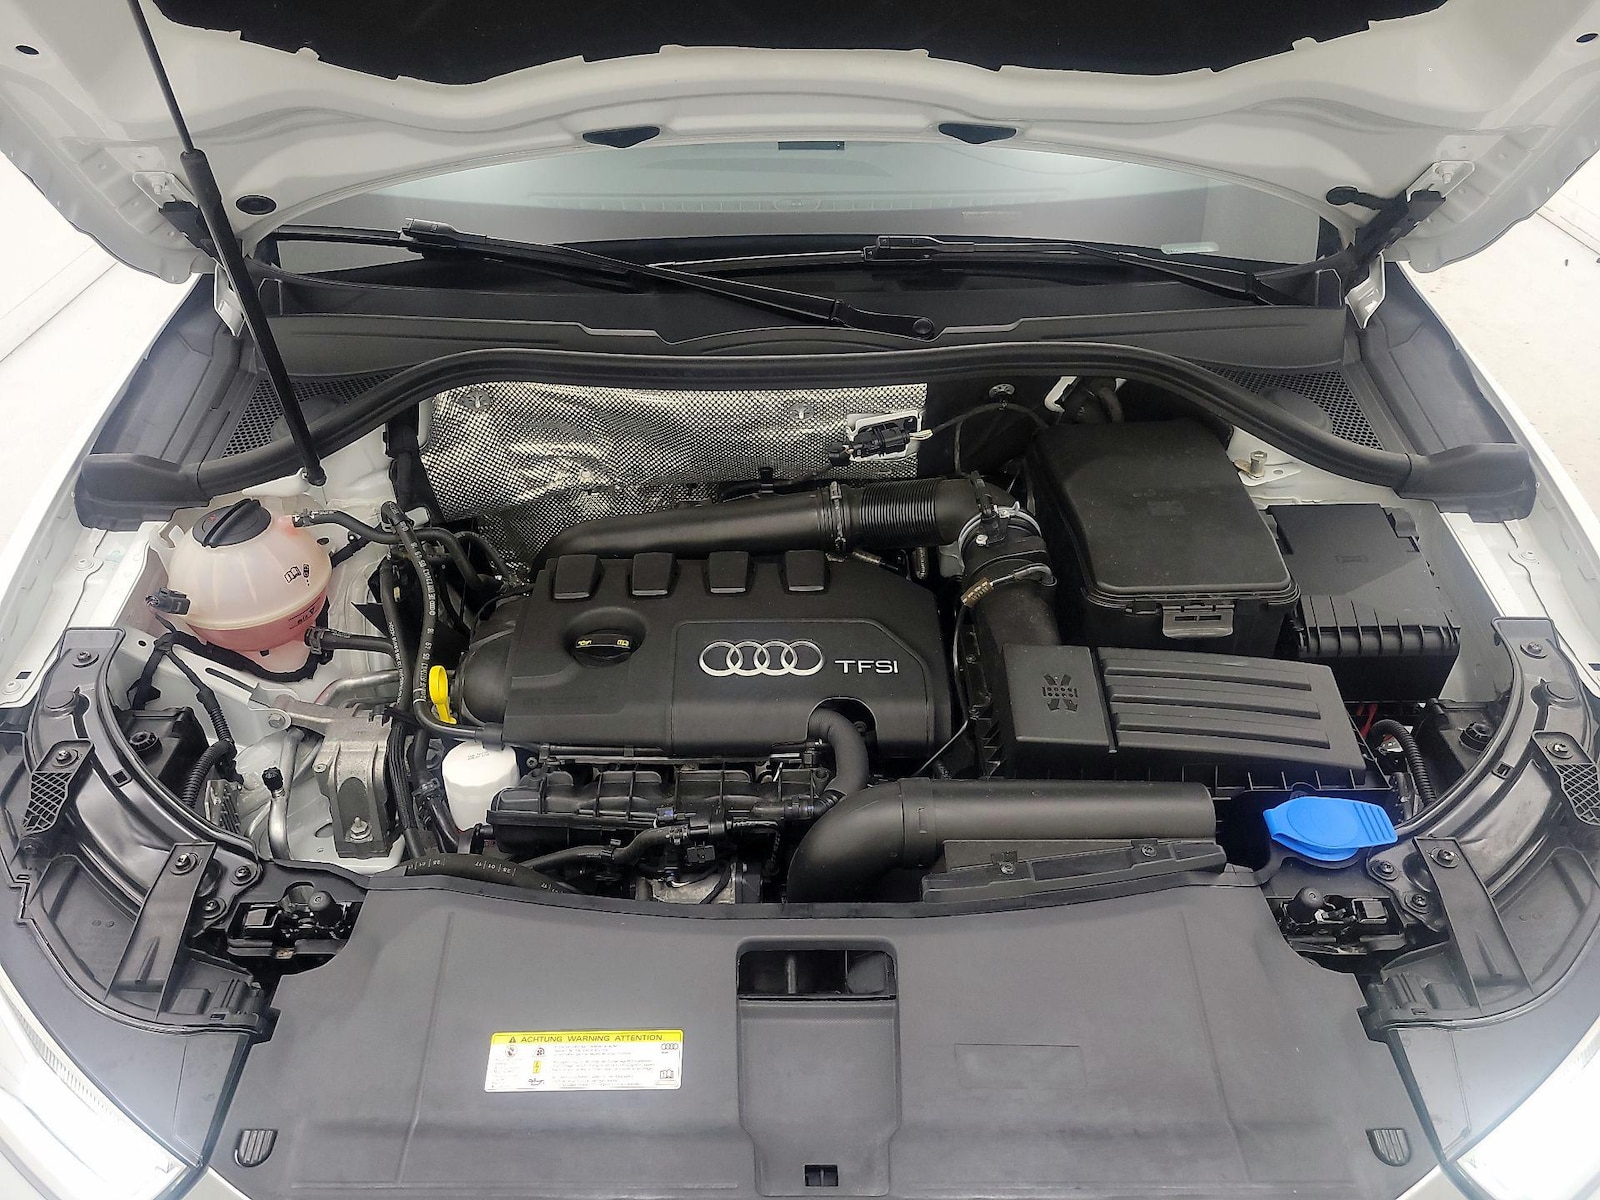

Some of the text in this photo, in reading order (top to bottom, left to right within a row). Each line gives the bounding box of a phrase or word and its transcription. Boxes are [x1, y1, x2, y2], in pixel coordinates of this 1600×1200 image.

[834, 659, 899, 674] TFSI
[520, 1034, 663, 1043] ACHTUNG WARNING ATTENTION
